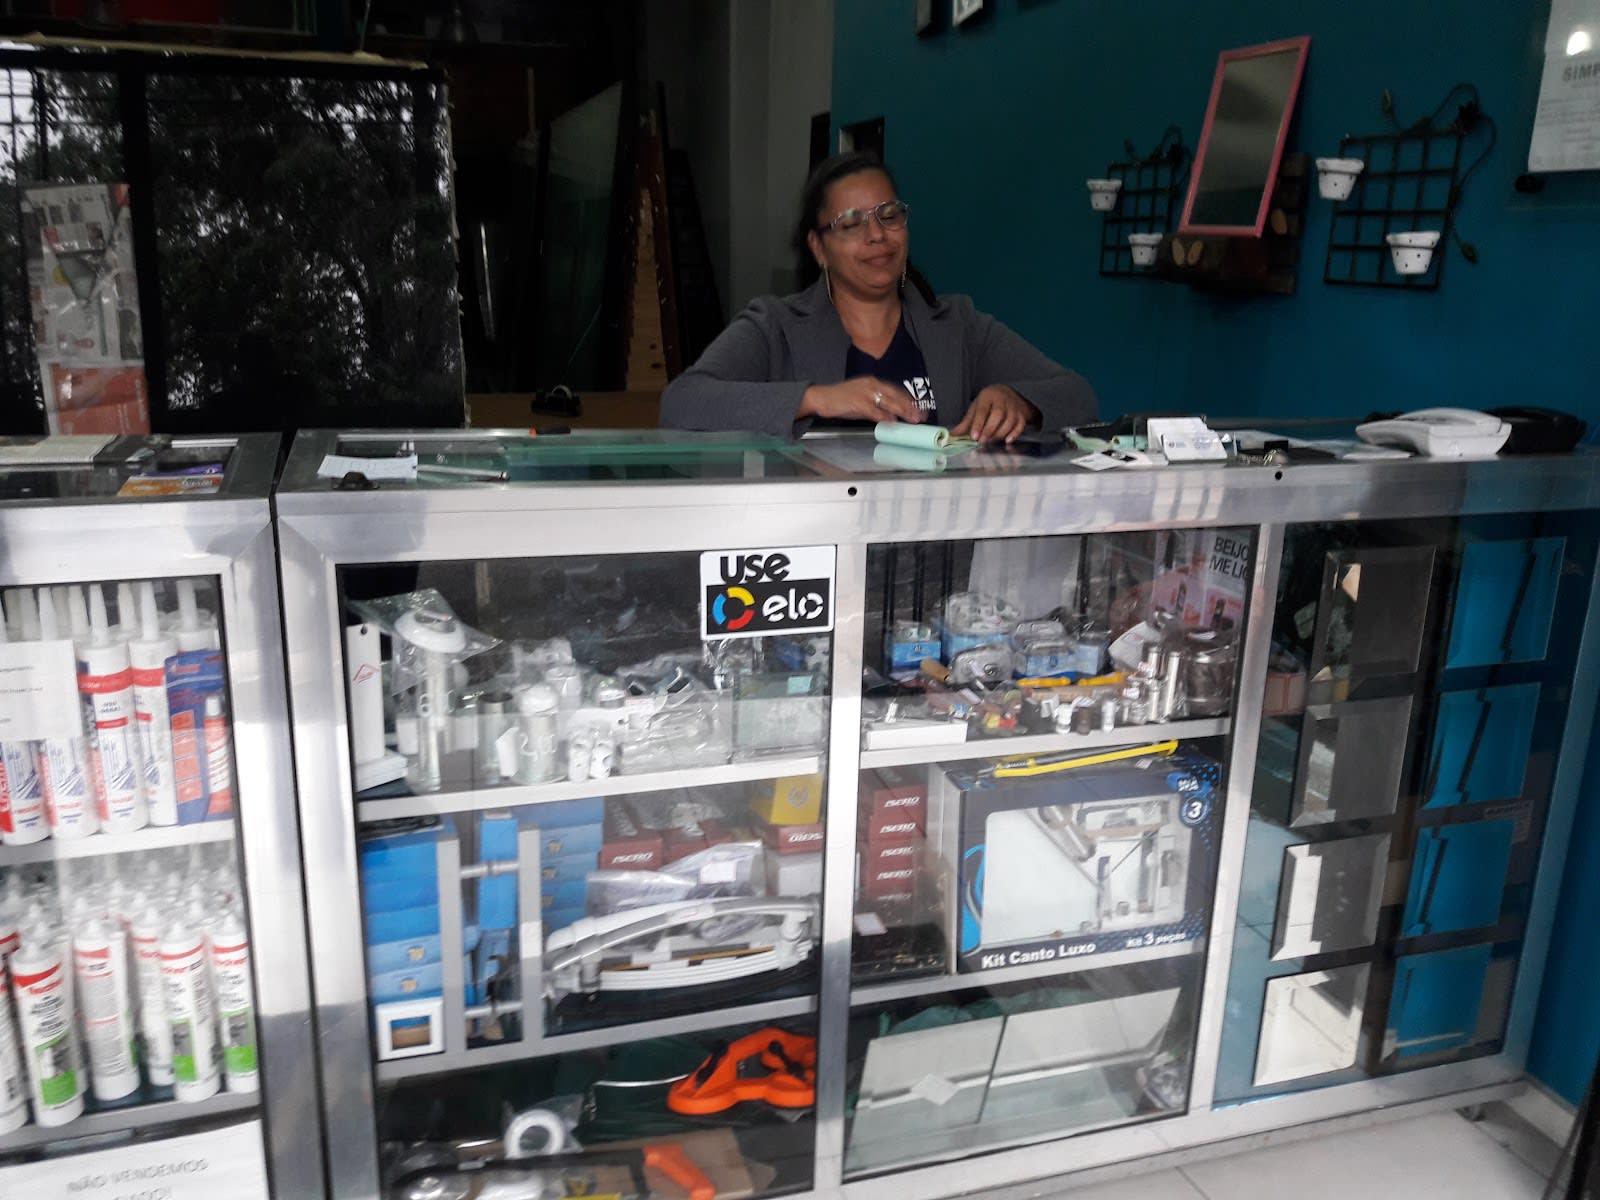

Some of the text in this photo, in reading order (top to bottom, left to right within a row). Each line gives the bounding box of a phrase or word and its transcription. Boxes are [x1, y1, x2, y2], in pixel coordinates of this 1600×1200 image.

[762, 588, 825, 622] elo
[1188, 801, 1202, 818] 3
[1144, 932, 1155, 946] 3
[981, 942, 1097, 969] Kit Canto Luxo
[111, 1158, 210, 1184] VENDEMOS
